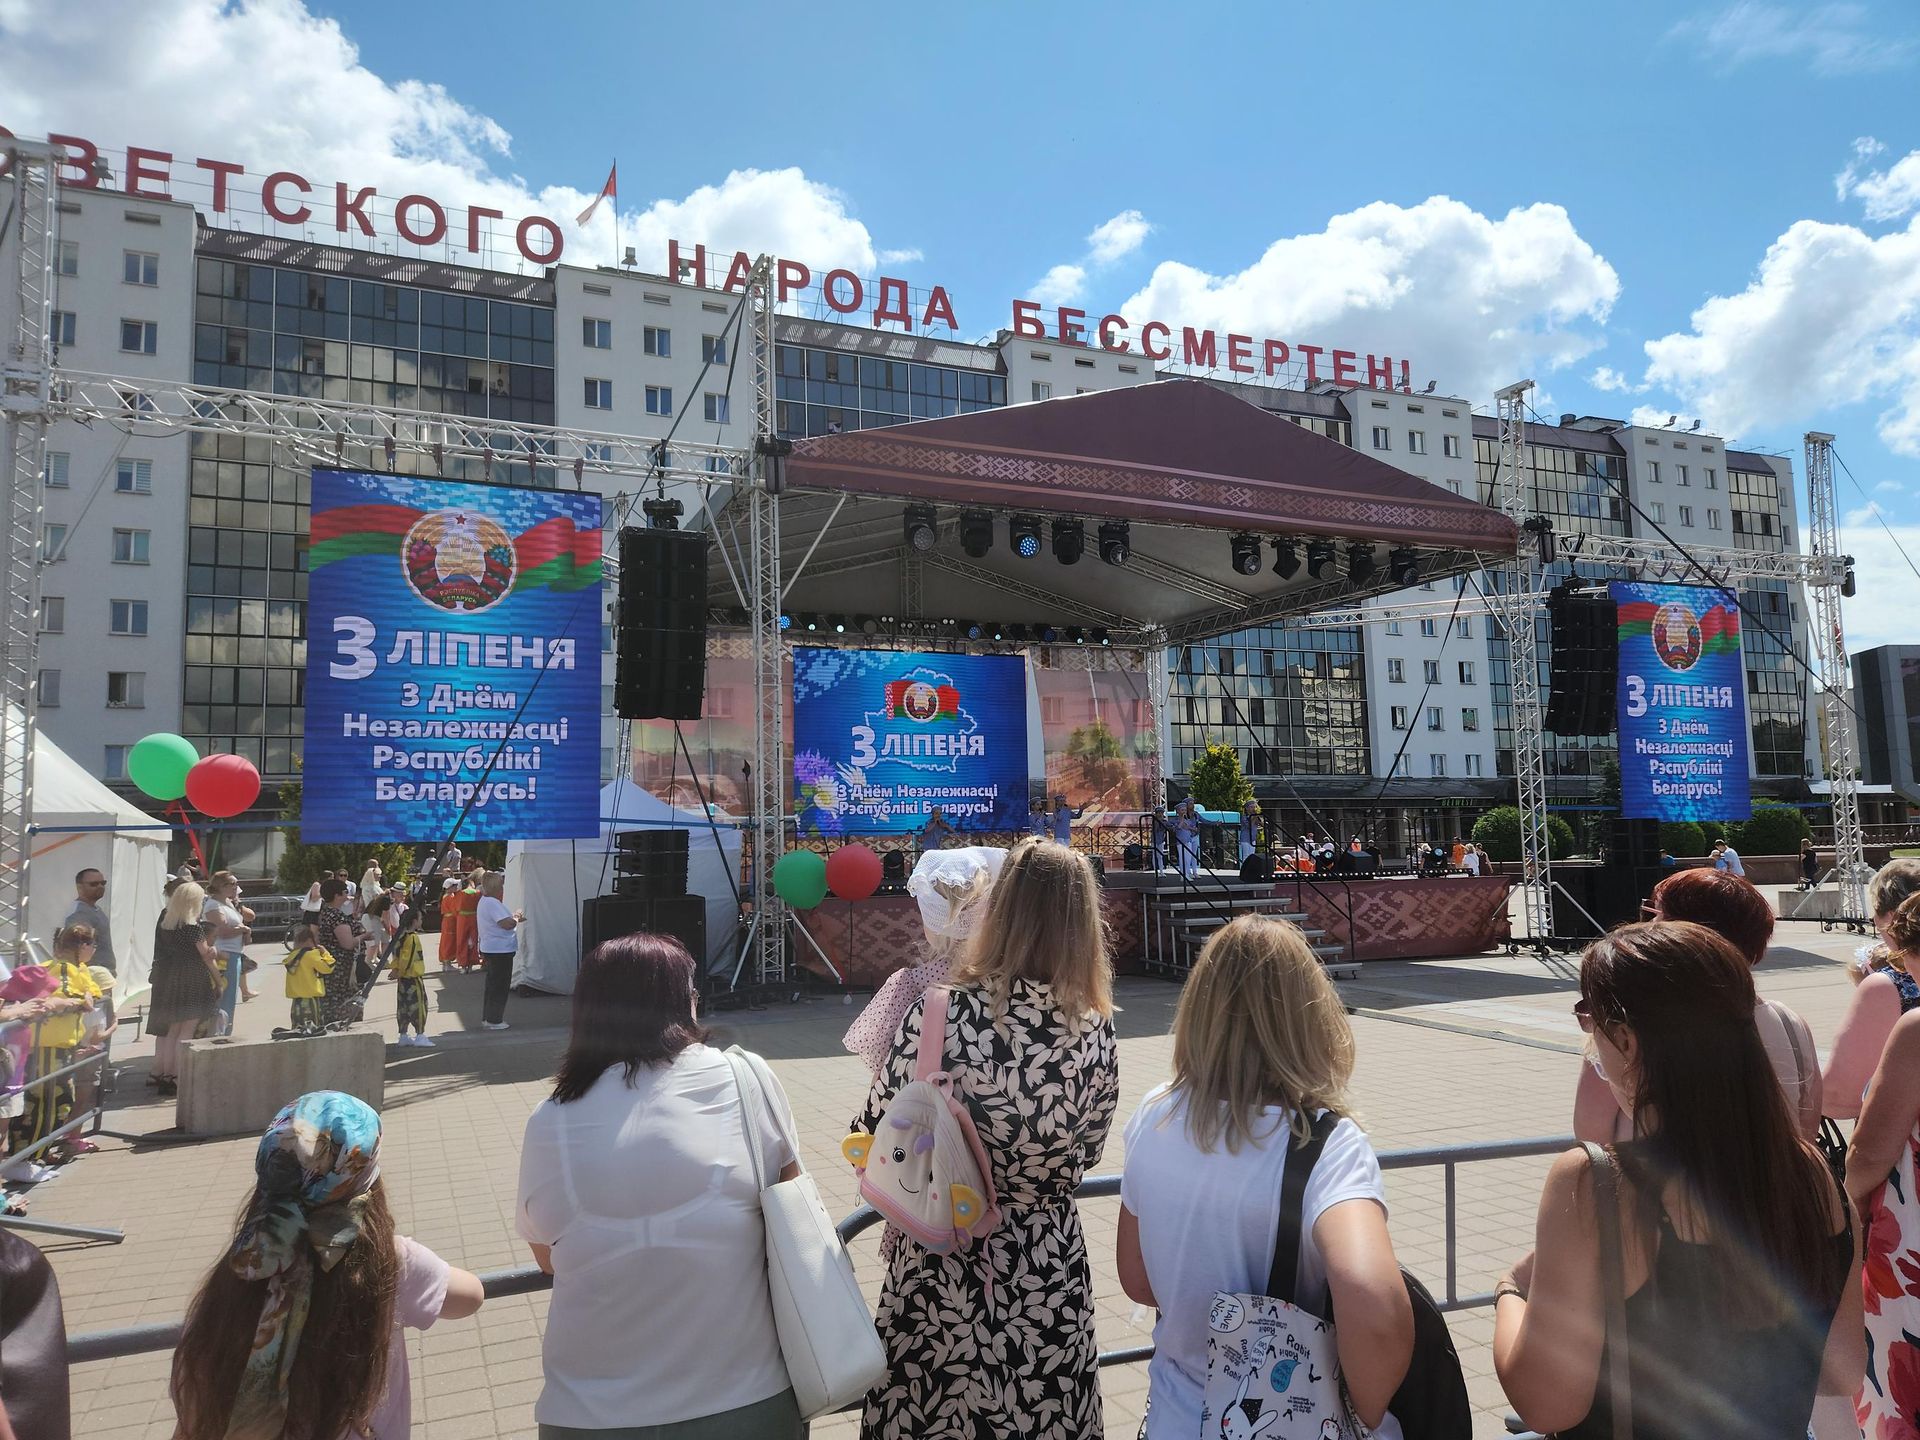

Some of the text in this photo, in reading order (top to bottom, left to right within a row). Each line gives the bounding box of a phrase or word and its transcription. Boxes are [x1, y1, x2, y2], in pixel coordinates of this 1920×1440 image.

[669, 239, 959, 331] НАРОДА
[1012, 299, 1412, 395] БЕССМЕРТЕН!
[329, 616, 576, 680] 3 ЛІПЕНЯ
[428, 684, 516, 713] Днём
[1626, 675, 1733, 717] 3 ЛІПЕНЯ
[343, 713, 568, 745] Незалежнасці
[1671, 719, 1709, 738] Днём
[850, 725, 985, 767] 3 ЛІПЕНЯ
[1635, 738, 1734, 758] Незалежнасці
[373, 745, 541, 775] Рэспублікі
[1650, 759, 1723, 779] Рэспублікі
[375, 776, 537, 807] Беларусь!
[851, 784, 893, 800] Днём
[897, 783, 998, 799] Незалежнасці
[1652, 779, 1723, 800] Беларусь!
[839, 800, 918, 817] Рэспублікі
[1220, 1303, 1239, 1330] HAVE
[1279, 1348, 1299, 1361] Rabit
[1286, 1334, 1311, 1360] Rabit
[1223, 1364, 1242, 1381] Rabit
